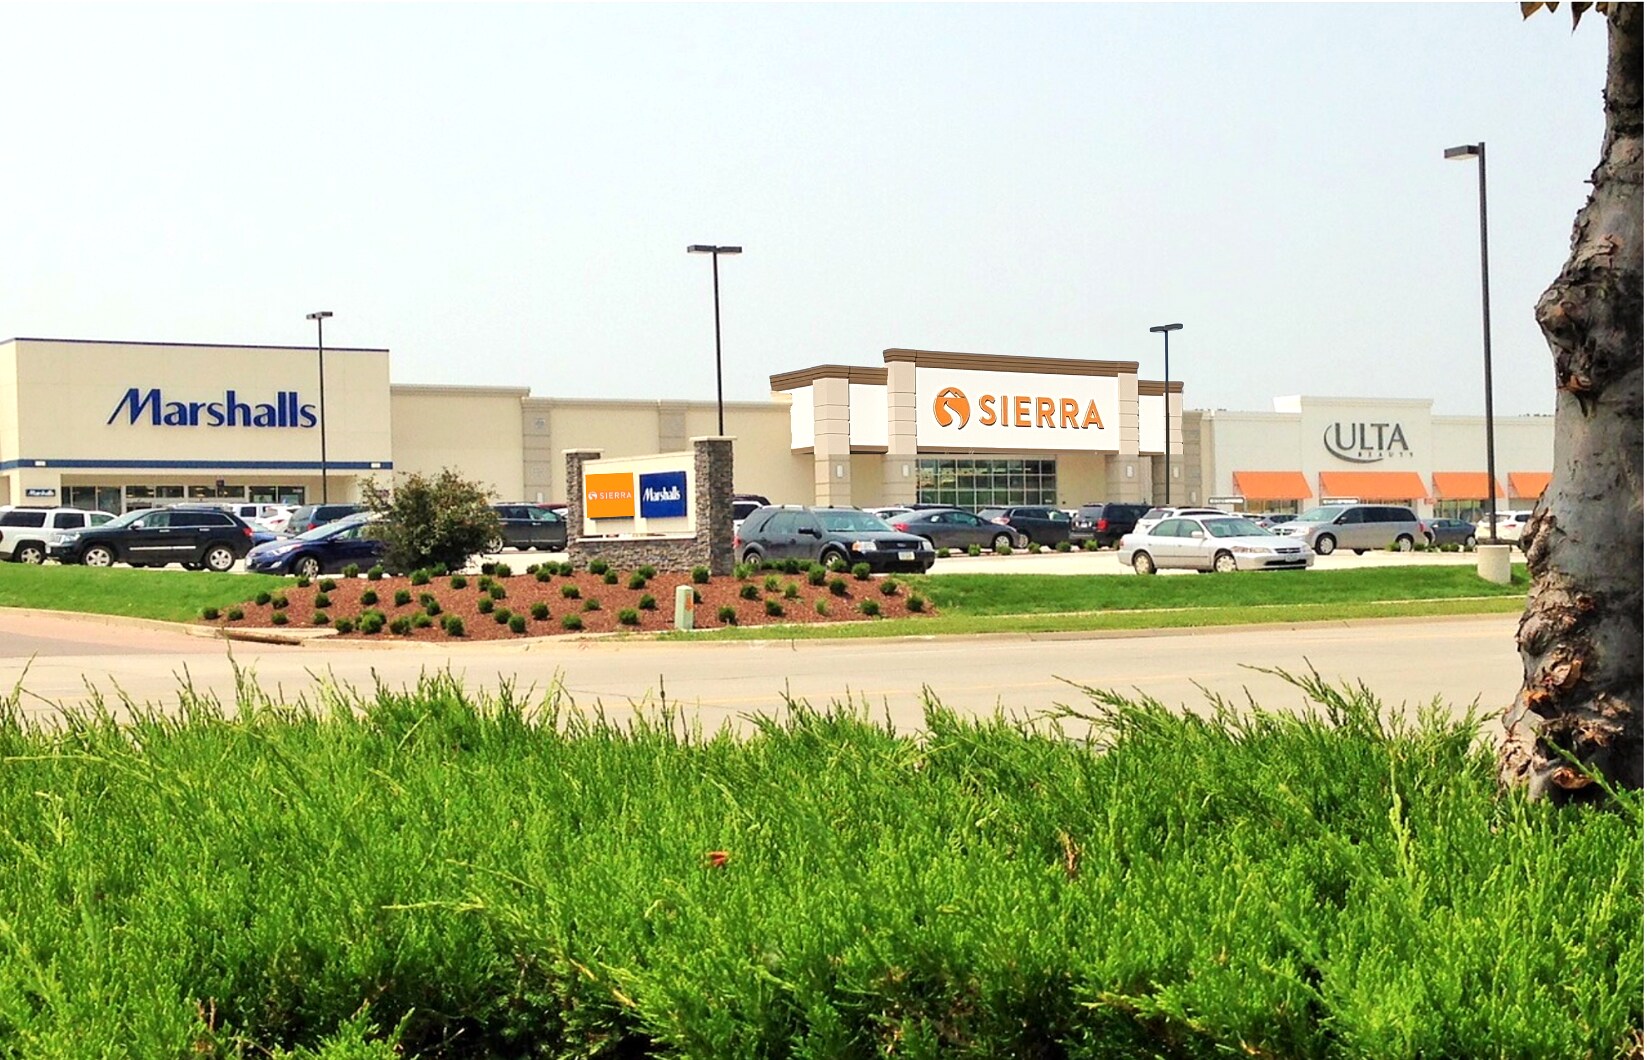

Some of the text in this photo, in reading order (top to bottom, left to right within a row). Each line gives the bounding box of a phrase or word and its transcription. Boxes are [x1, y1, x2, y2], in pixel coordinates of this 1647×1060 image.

[107, 388, 317, 428] Marshalls
[978, 394, 1105, 430] SIERRA
[1335, 422, 1409, 451] ULTA
[599, 491, 632, 500] SIERRA
[642, 485, 681, 502] Marshalls
